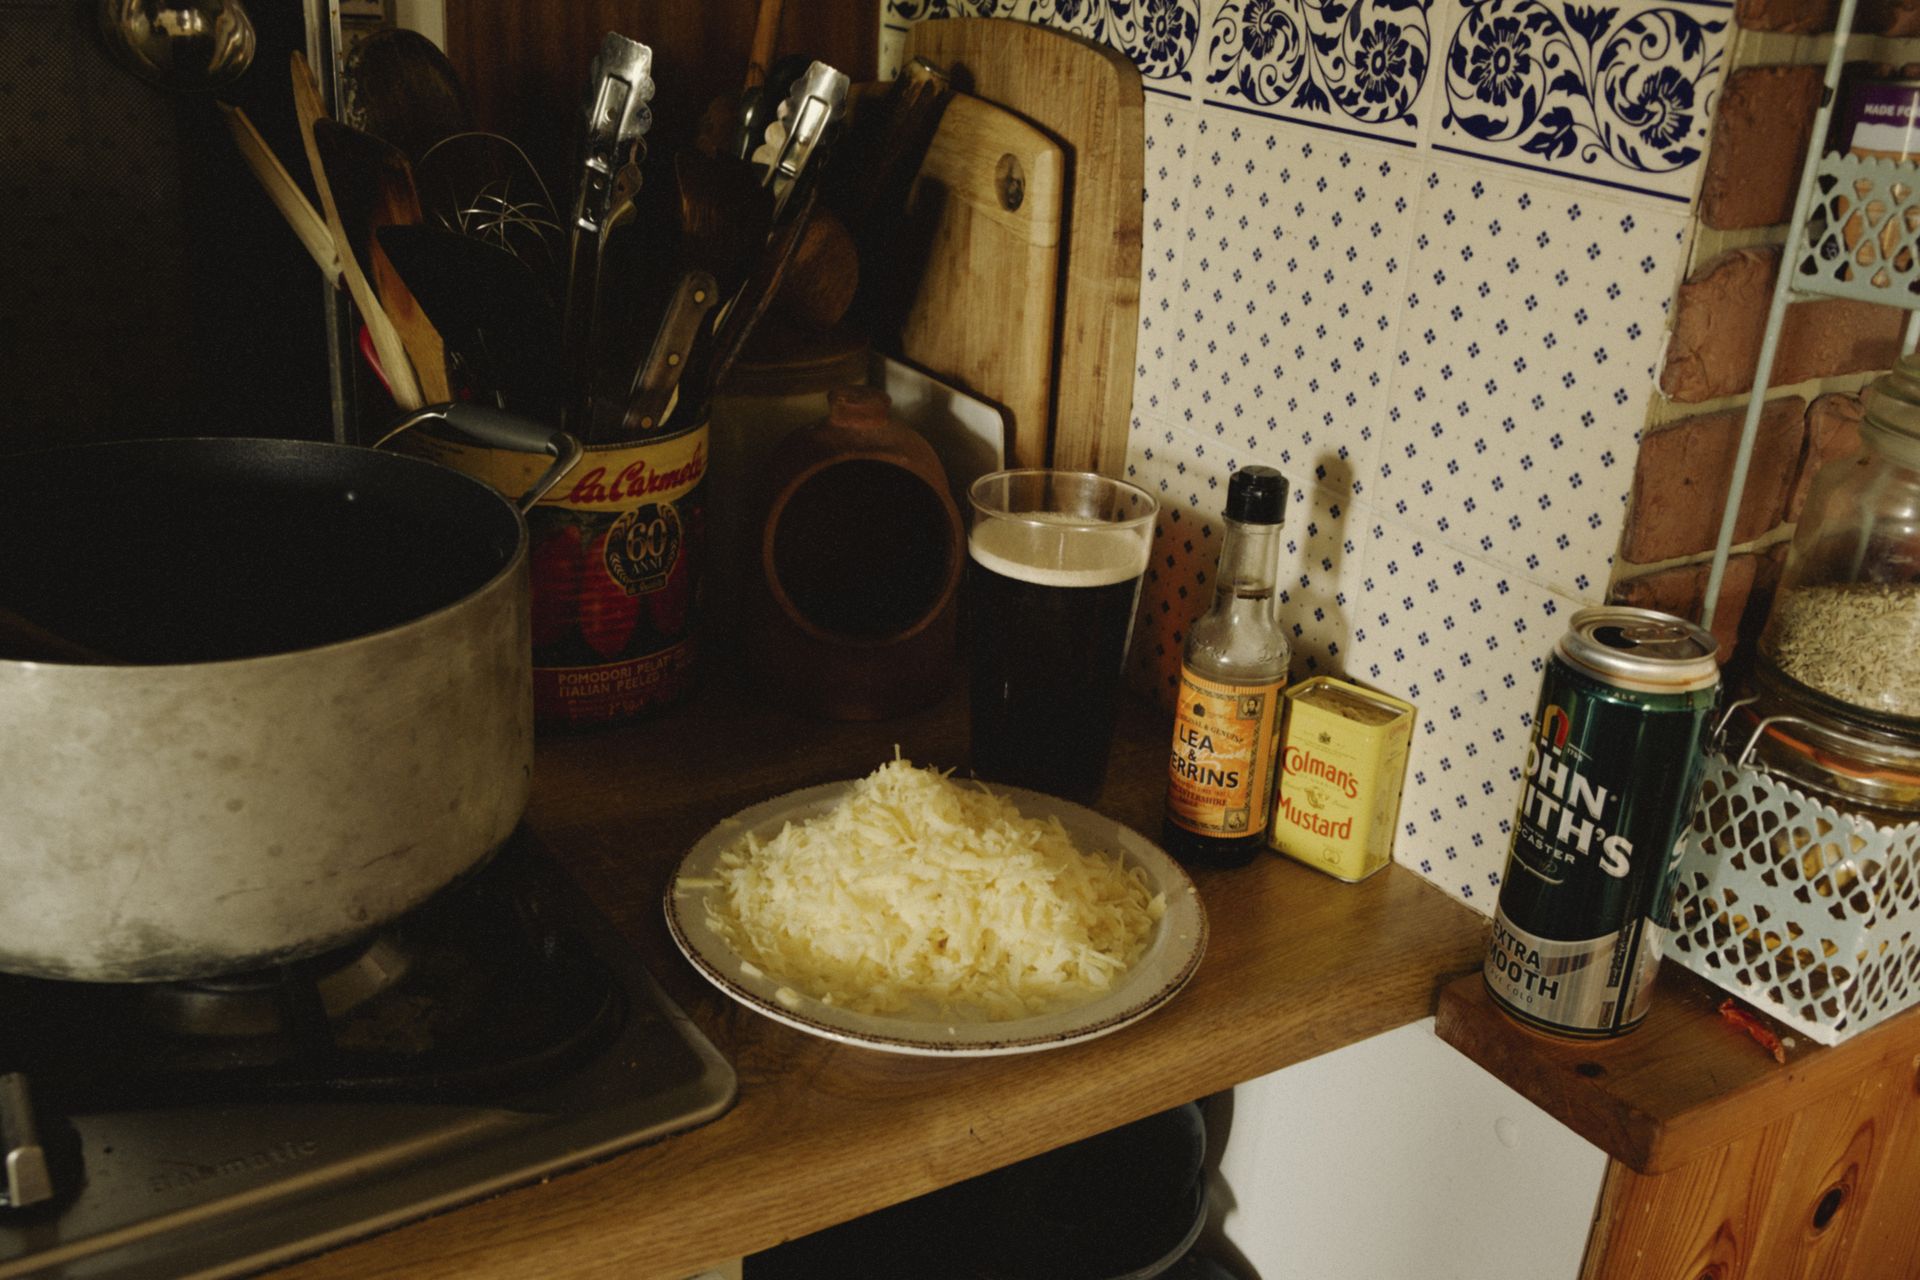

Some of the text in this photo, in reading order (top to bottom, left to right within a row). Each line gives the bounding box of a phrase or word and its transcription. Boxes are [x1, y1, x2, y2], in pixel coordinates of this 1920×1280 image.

[1864, 103, 1920, 118] MADE FO
[626, 518, 667, 561] 60
[558, 666, 633, 685] POMODORI
[559, 682, 611, 698] ITALIAN
[1179, 723, 1215, 754] LEA
[1188, 748, 1197, 762] &
[1170, 750, 1239, 788] ERRINS
[1281, 745, 1359, 799] Colman's
[1526, 742, 1609, 821] OHN
[1275, 788, 1353, 840] Mustard
[1523, 783, 1634, 878] ITH'S
